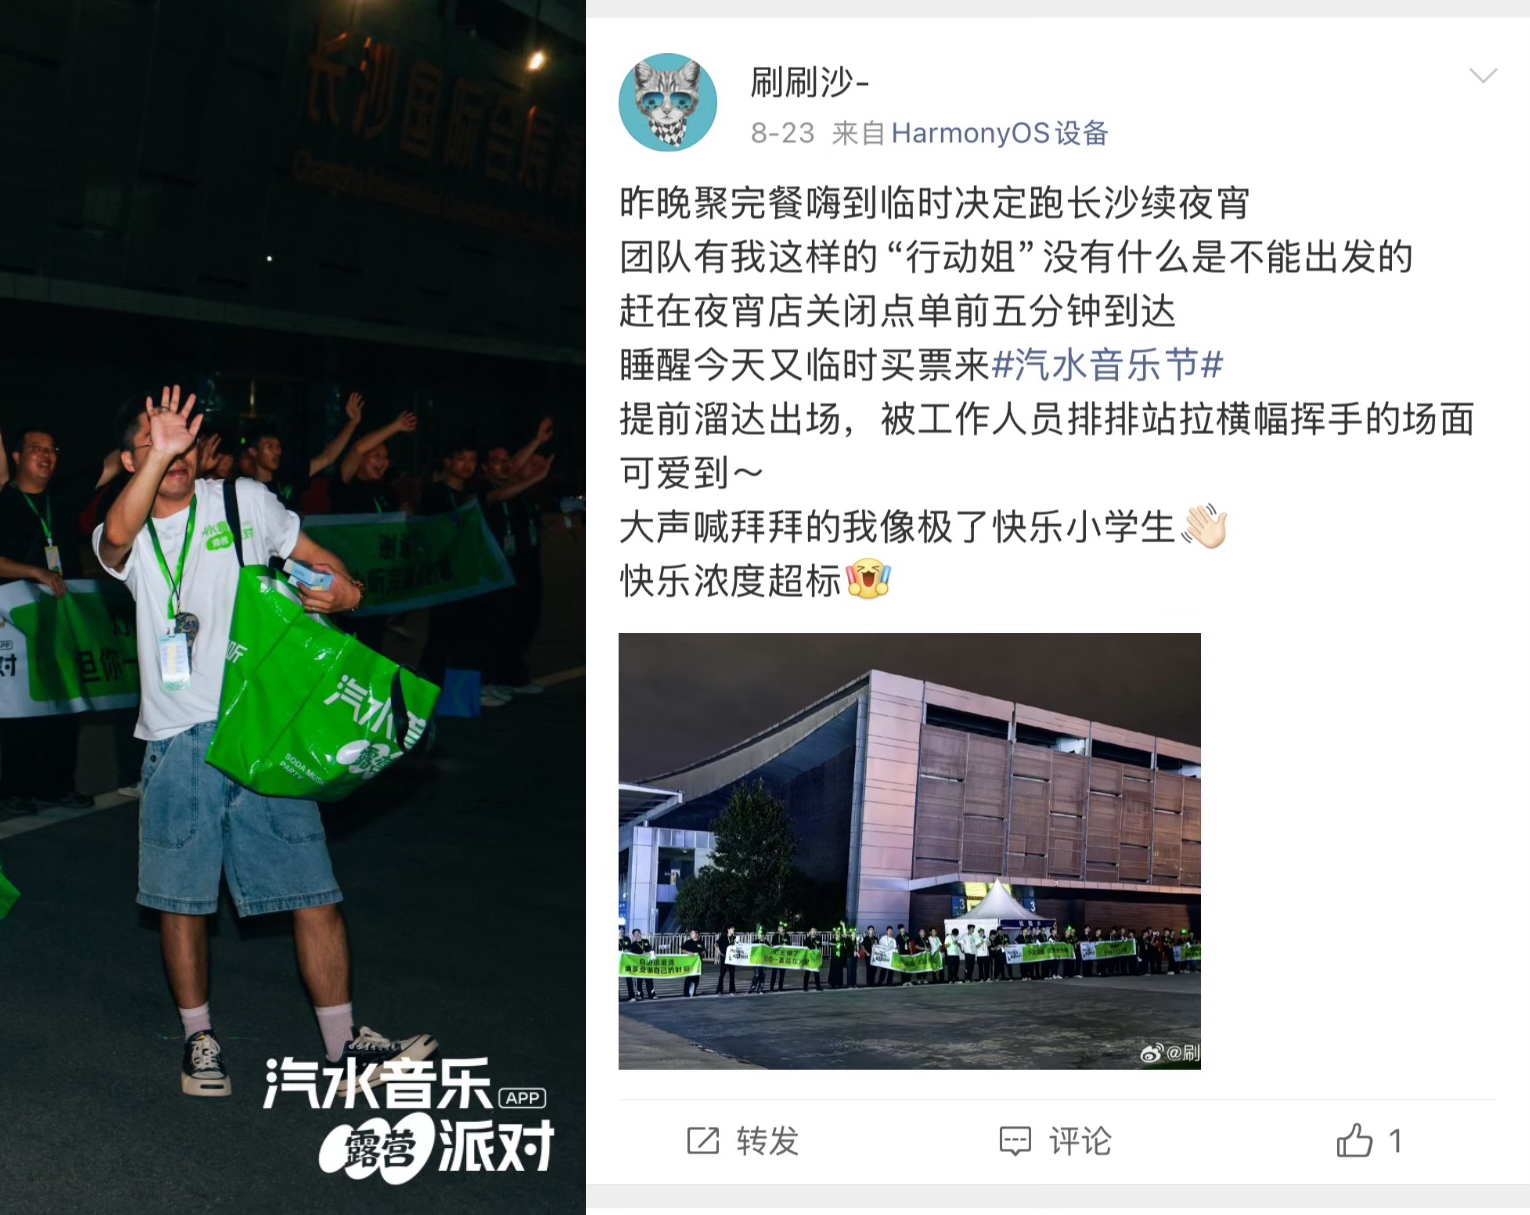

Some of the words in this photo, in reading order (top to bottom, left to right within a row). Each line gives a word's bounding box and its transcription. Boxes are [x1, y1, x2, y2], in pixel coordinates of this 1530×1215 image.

[750, 64, 870, 99] 刷刷沙-
[751, 121, 815, 144] 8-23
[620, 184, 1250, 221] 昨晚聚完餐嗨到临时决定跑长沙续夜宵
[619, 292, 1176, 329] 赶在夜宵店关闭点单前五分钟到达
[619, 400, 1475, 438] 提前溜达出场，被工作人员排排站拉横幅挥手的场面
[619, 508, 1175, 545] 大声喊拜拜的我像极了快乐小学生
[619, 562, 841, 599] 快乐浓度超标
[279, 760, 305, 780] PARTY
[284, 753, 307, 773] SODA
[736, 1125, 799, 1157] 转发
[1048, 1125, 1113, 1157] 评论
[1389, 1128, 1400, 1154] 1
